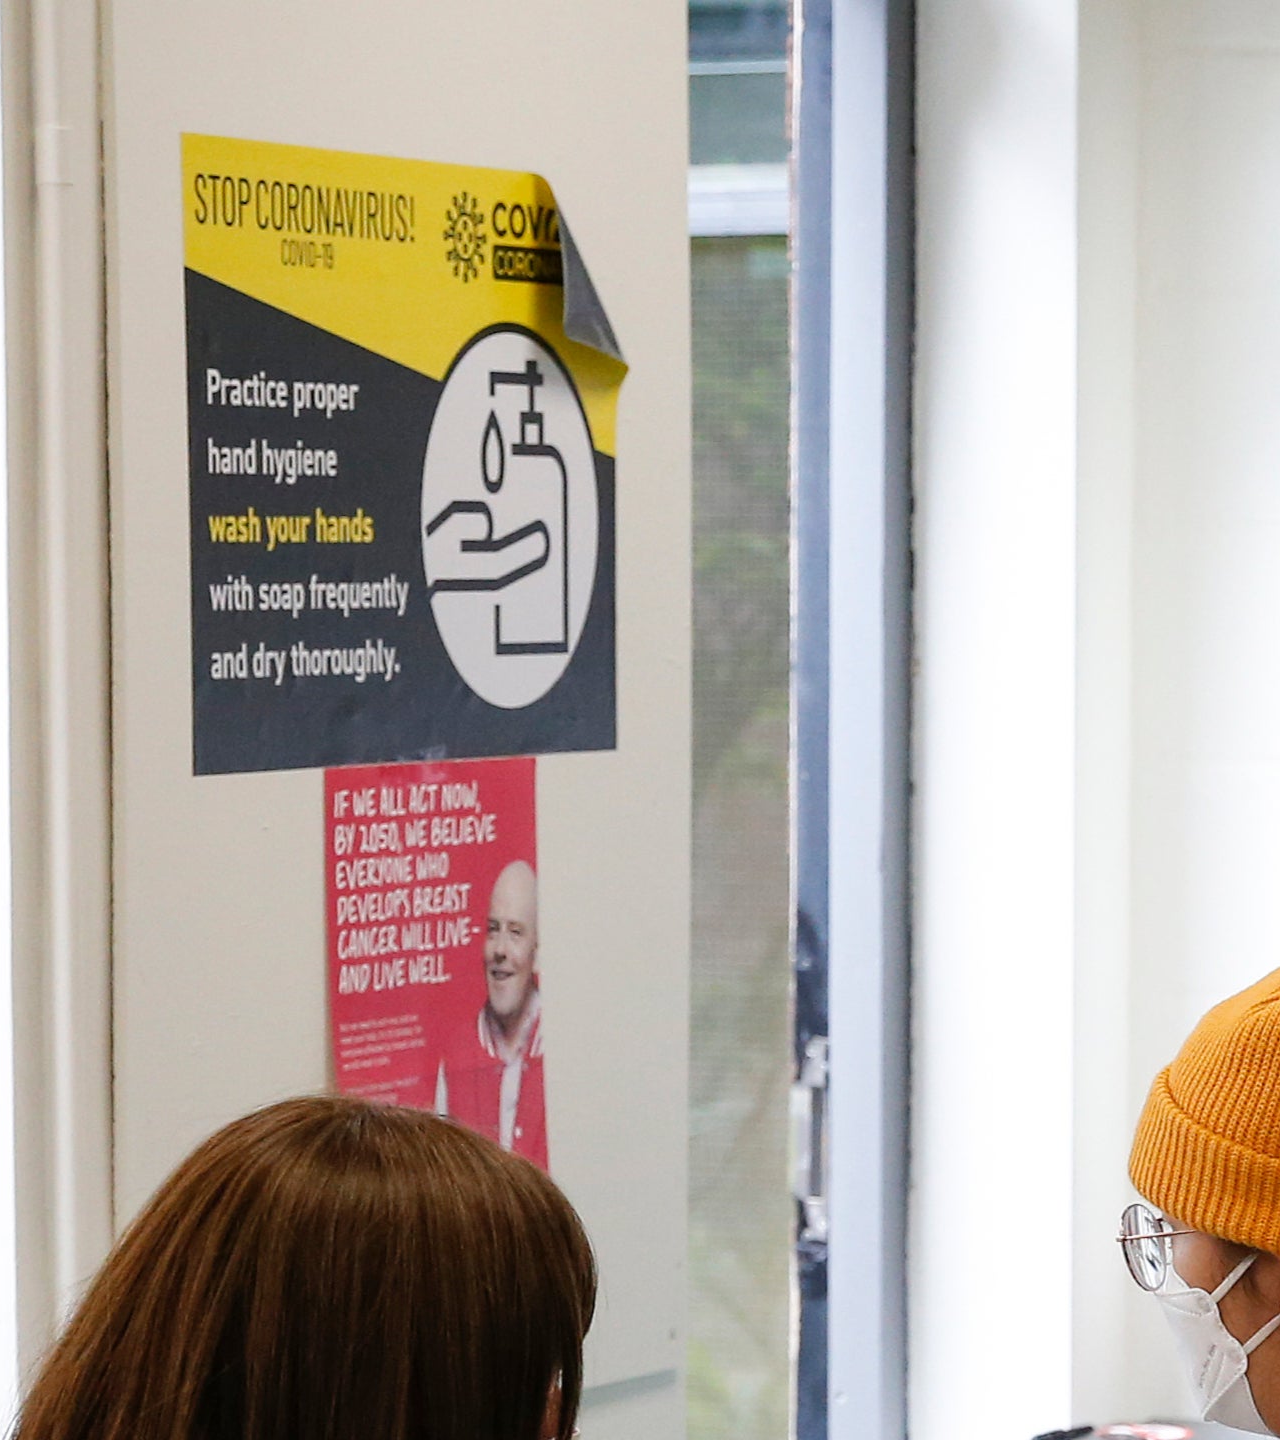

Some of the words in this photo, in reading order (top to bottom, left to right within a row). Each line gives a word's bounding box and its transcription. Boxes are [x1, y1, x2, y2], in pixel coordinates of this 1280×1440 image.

[194, 174, 251, 227] STOP
[255, 180, 416, 243] CORONAVIRUS!
[281, 238, 334, 270] COVID-19
[207, 369, 287, 410] Practice
[293, 382, 360, 418] proper
[208, 438, 257, 476] hand
[262, 441, 338, 484] hygiene
[209, 508, 261, 543] wash
[267, 515, 311, 551] your
[316, 508, 374, 543] hands
[210, 577, 253, 612] with
[259, 581, 304, 618] soap
[310, 577, 409, 617] frequently
[210, 643, 249, 680] and
[252, 643, 287, 685] dry
[291, 639, 401, 683] thoroughly.
[334, 789, 349, 819] IF
[353, 788, 376, 818] WE
[380, 785, 406, 816] ALL
[409, 783, 437, 813] ACT
[441, 780, 482, 813] NOW,
[334, 822, 355, 855] BY
[360, 821, 403, 853] 2050,
[405, 819, 428, 847] WE
[431, 813, 497, 847] BELIEVE
[336, 854, 413, 890] EVERYONE
[416, 852, 450, 880] WHO
[336, 887, 410, 926] DEVELOPS
[413, 882, 472, 918] BREAST
[337, 923, 398, 960] CANCER
[402, 920, 434, 952] WILL
[339, 963, 370, 994] AND
[374, 958, 406, 991] LIVE
[409, 954, 452, 984] WELL.
